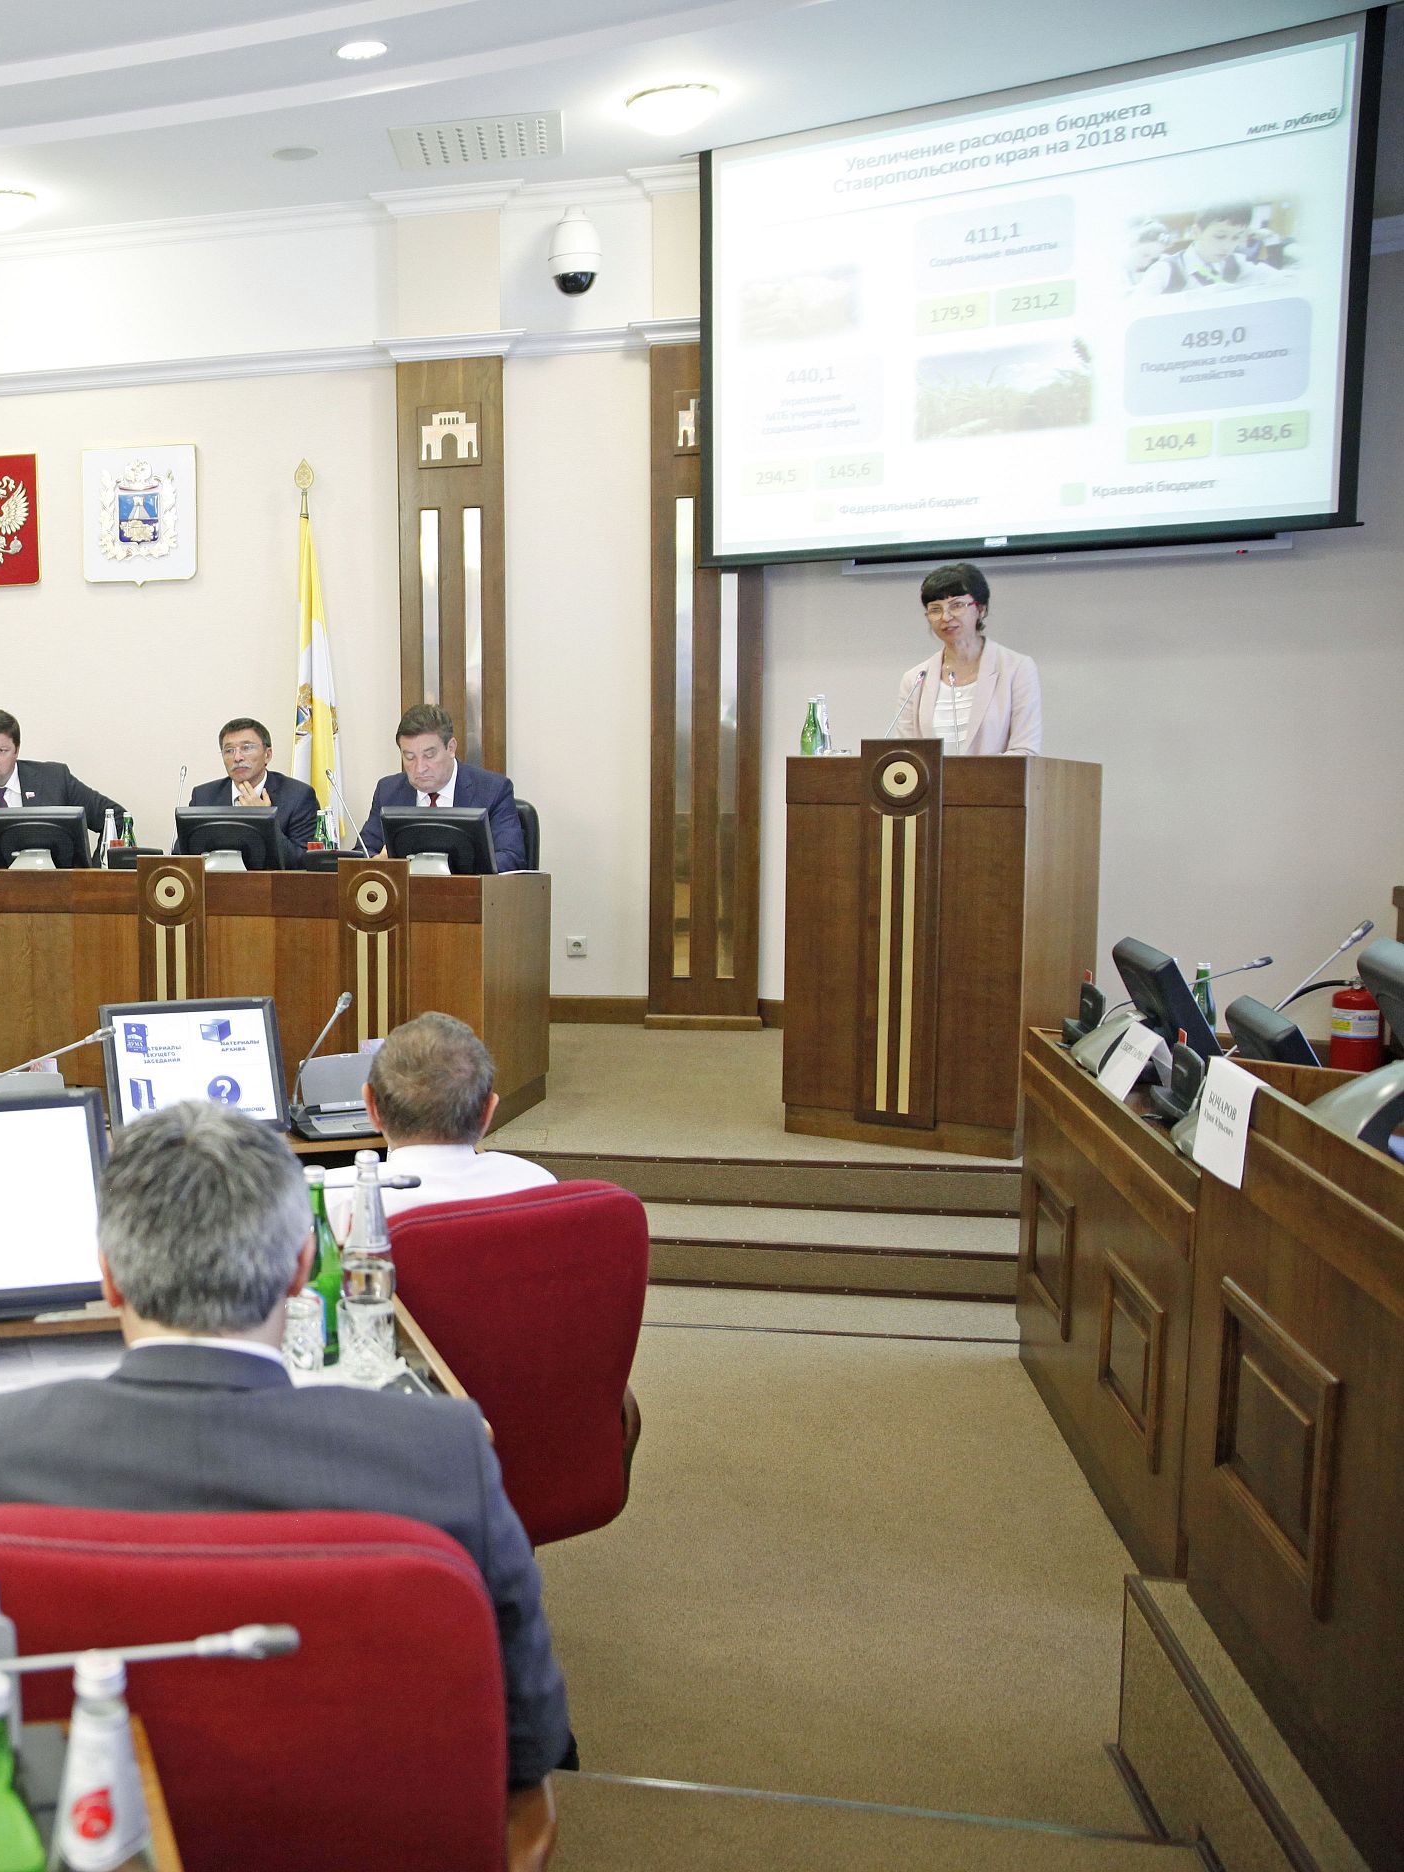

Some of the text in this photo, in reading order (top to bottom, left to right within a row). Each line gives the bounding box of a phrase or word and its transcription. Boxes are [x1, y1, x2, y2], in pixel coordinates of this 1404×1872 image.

[1246, 107, 1338, 136] млн. рублей
[845, 102, 1153, 172] Увеличение расходов бюджета
[833, 119, 1169, 194] Ставропольского края на 2018 год
[963, 222, 1021, 245] 411,1
[929, 240, 1059, 268] Социальные выплаты
[1010, 292, 1060, 313] 231,2
[929, 303, 977, 324] 179,9
[1180, 326, 1247, 349] 489,0
[1140, 347, 1289, 373] Поддержка сельского
[785, 366, 837, 385] 440,1
[1178, 367, 1246, 384] хозяйства
[1143, 432, 1198, 452] 140,4
[1235, 422, 1294, 444] 348,6
[755, 468, 798, 486] 294,5
[827, 461, 872, 479] 145,6
[1091, 477, 1217, 498] Краевой бюджет
[838, 494, 981, 516] Федеральный бюджет
[146, 1044, 182, 1052] АТЕРИАЛЫ
